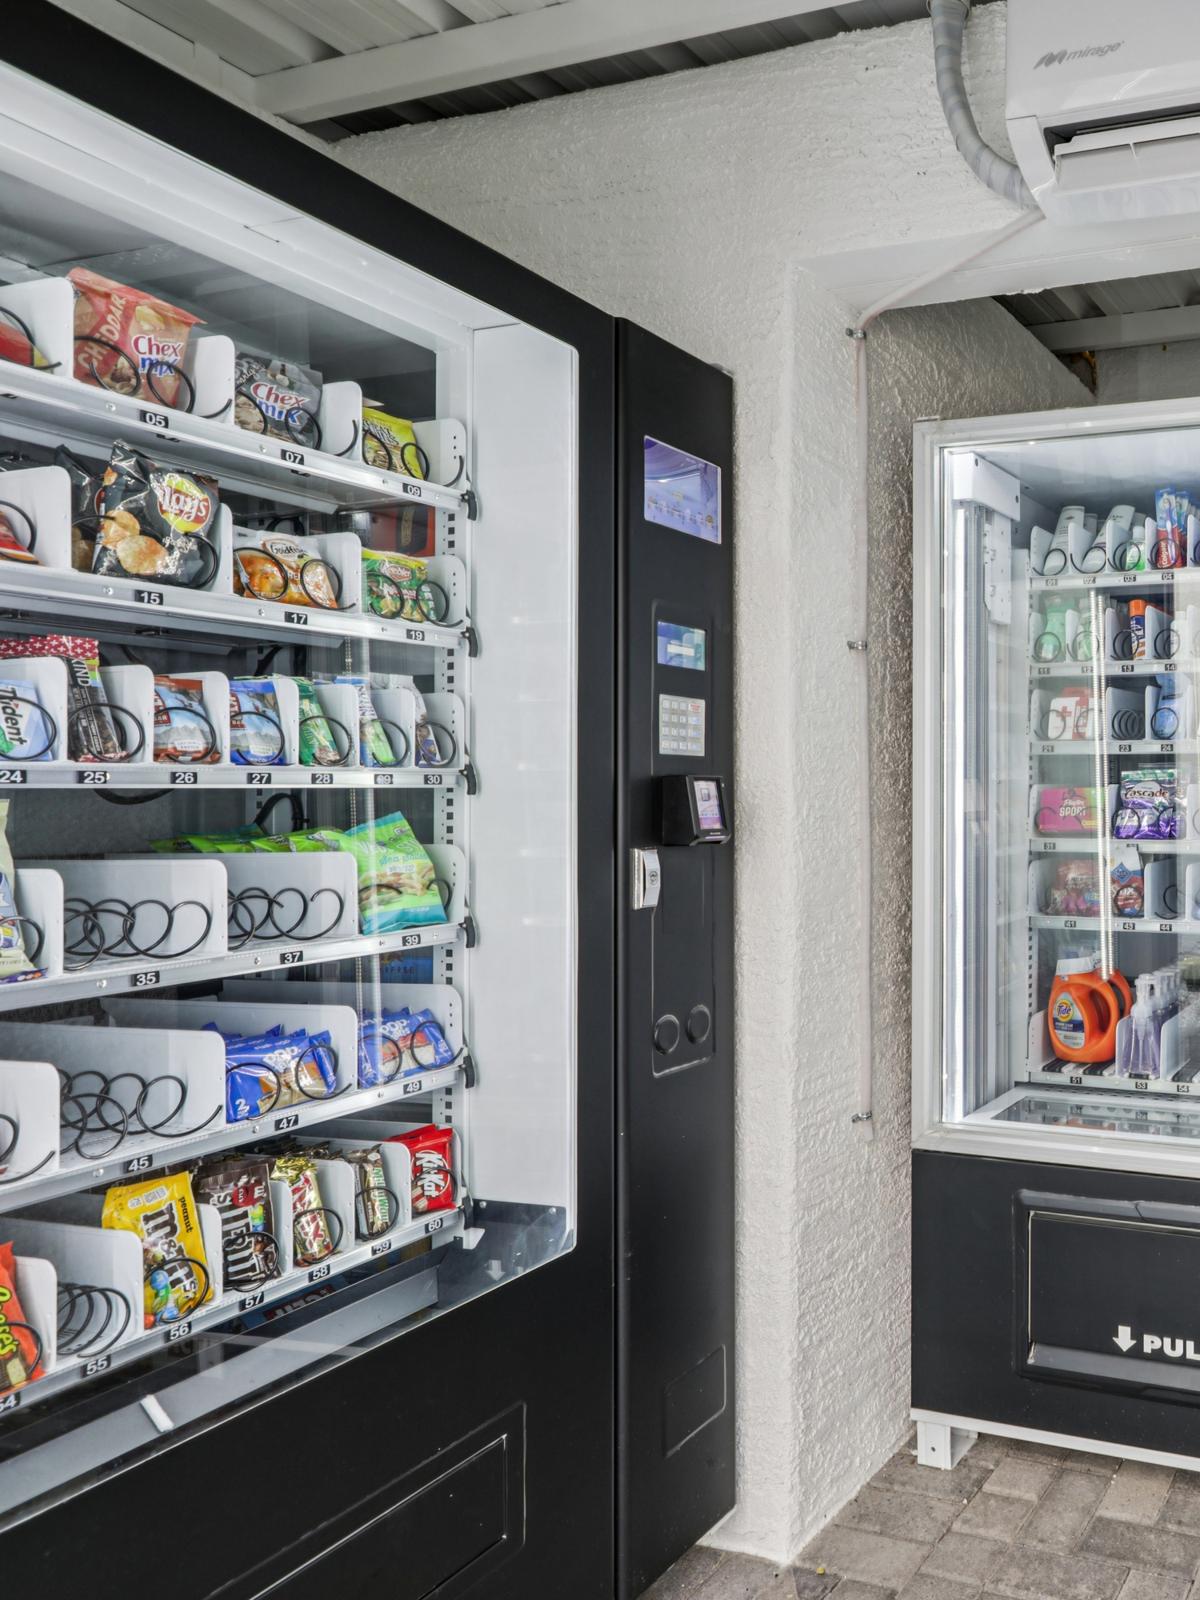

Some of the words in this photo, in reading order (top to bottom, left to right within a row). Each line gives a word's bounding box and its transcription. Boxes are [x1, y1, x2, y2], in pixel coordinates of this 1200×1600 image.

[1066, 42, 1122, 60] mirage
[131, 335, 183, 357] Chex
[250, 381, 312, 408] Chex
[145, 412, 166, 428] 05
[285, 450, 302, 464] 07
[406, 484, 421, 497] 09
[139, 590, 160, 604] 15
[290, 613, 307, 625] 17
[409, 630, 424, 641] 19
[0, 770, 23, 784] 24
[83, 771, 105, 784] 25
[174, 772, 195, 784] 26
[251, 773, 269, 785] 27
[314, 774, 331, 785] 28
[426, 774, 441, 785] 30
[1123, 787, 1169, 800] Cascade
[1059, 806, 1087, 818] SPORT
[404, 935, 419, 946] 39
[283, 952, 301, 964] 37
[135, 972, 157, 986] 35
[1056, 1002, 1072, 1017] Tide
[405, 1082, 420, 1093] 49
[278, 1115, 296, 1130] 47
[127, 1156, 150, 1171] 45
[178, 1195, 194, 1234] peanut
[428, 1219, 442, 1231] 60
[375, 1241, 390, 1254] 59
[311, 1266, 329, 1279] 58
[244, 1295, 262, 1309] 57
[169, 1325, 189, 1341] 56
[86, 1357, 109, 1375] 55
